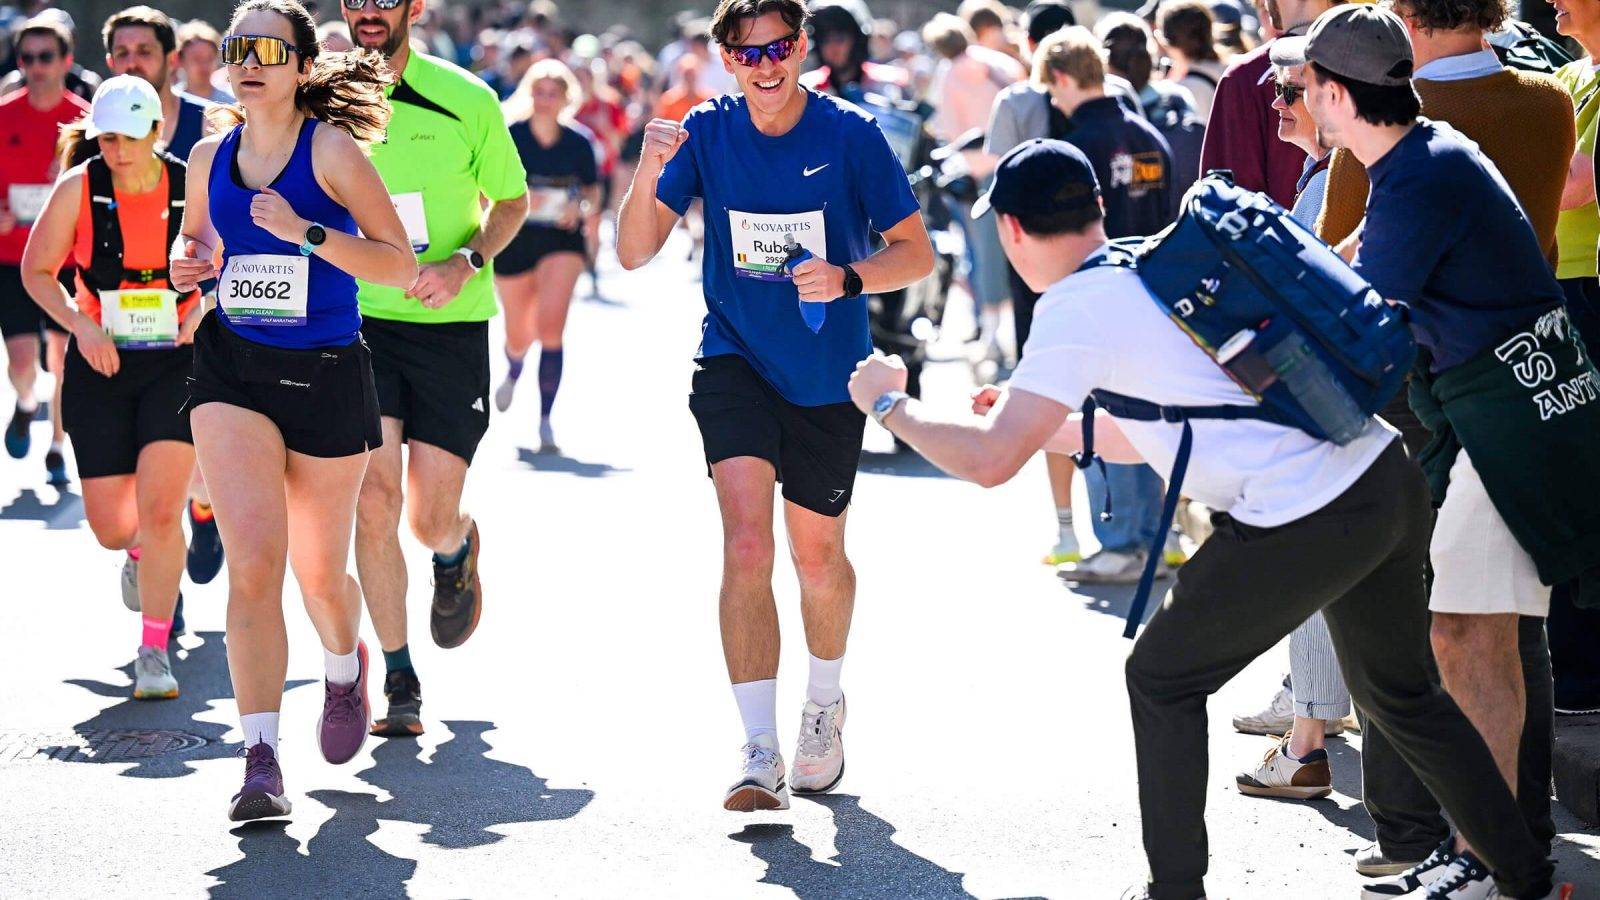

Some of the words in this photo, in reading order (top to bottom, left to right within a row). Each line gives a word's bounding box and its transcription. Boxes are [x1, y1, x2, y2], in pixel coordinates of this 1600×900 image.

[754, 222, 811, 232] NOVARTIS
[753, 240, 790, 254] Rube
[765, 256, 786, 264] 2952
[241, 264, 294, 275] NOVARTIS
[229, 279, 291, 300] 30662
[129, 313, 156, 325] Toni
[1532, 370, 1600, 422] ANT
